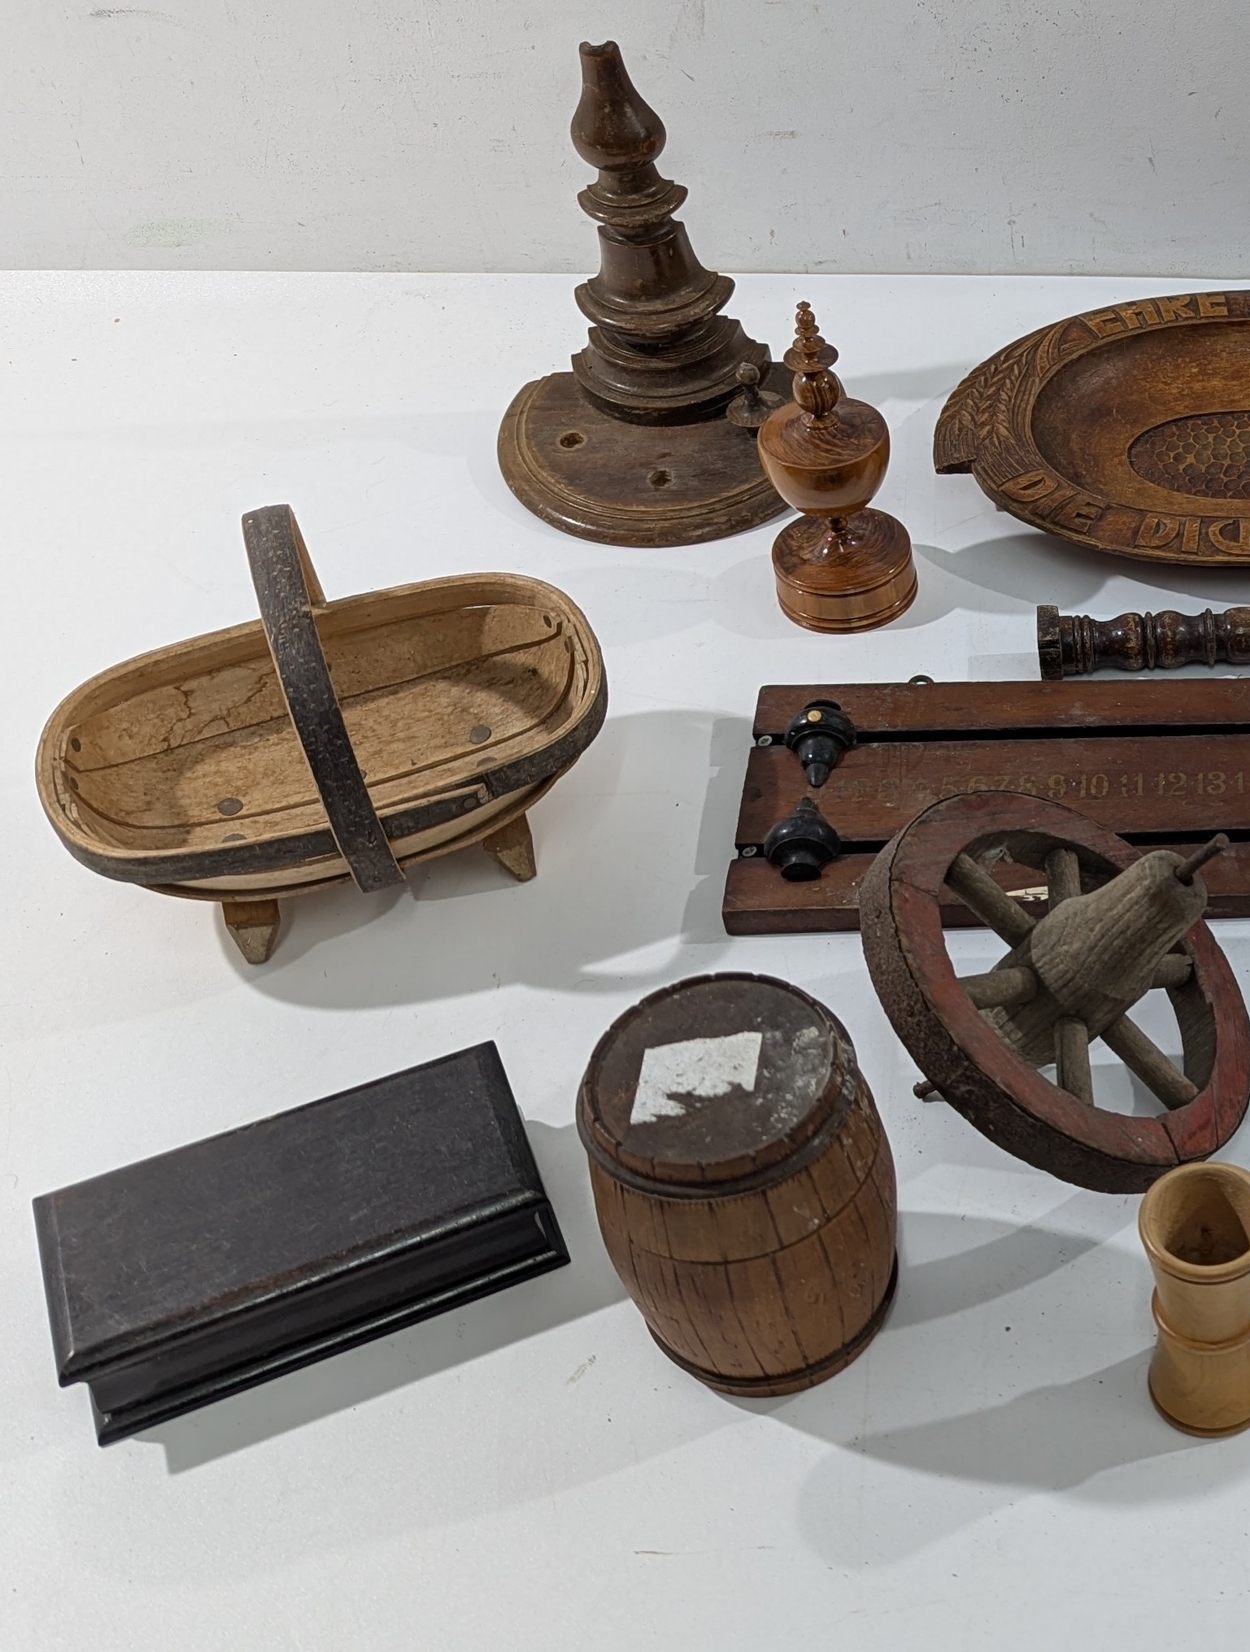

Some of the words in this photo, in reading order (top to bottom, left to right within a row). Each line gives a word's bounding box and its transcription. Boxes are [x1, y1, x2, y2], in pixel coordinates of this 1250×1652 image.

[1080, 291, 1229, 338] EHRE
[1000, 469, 1105, 533] DIE
[1048, 774, 1067, 798] 9
[1079, 773, 1110, 798] 10
[1120, 772, 1144, 796] 11
[1157, 772, 1187, 796] 12
[1197, 771, 1226, 795] 13
